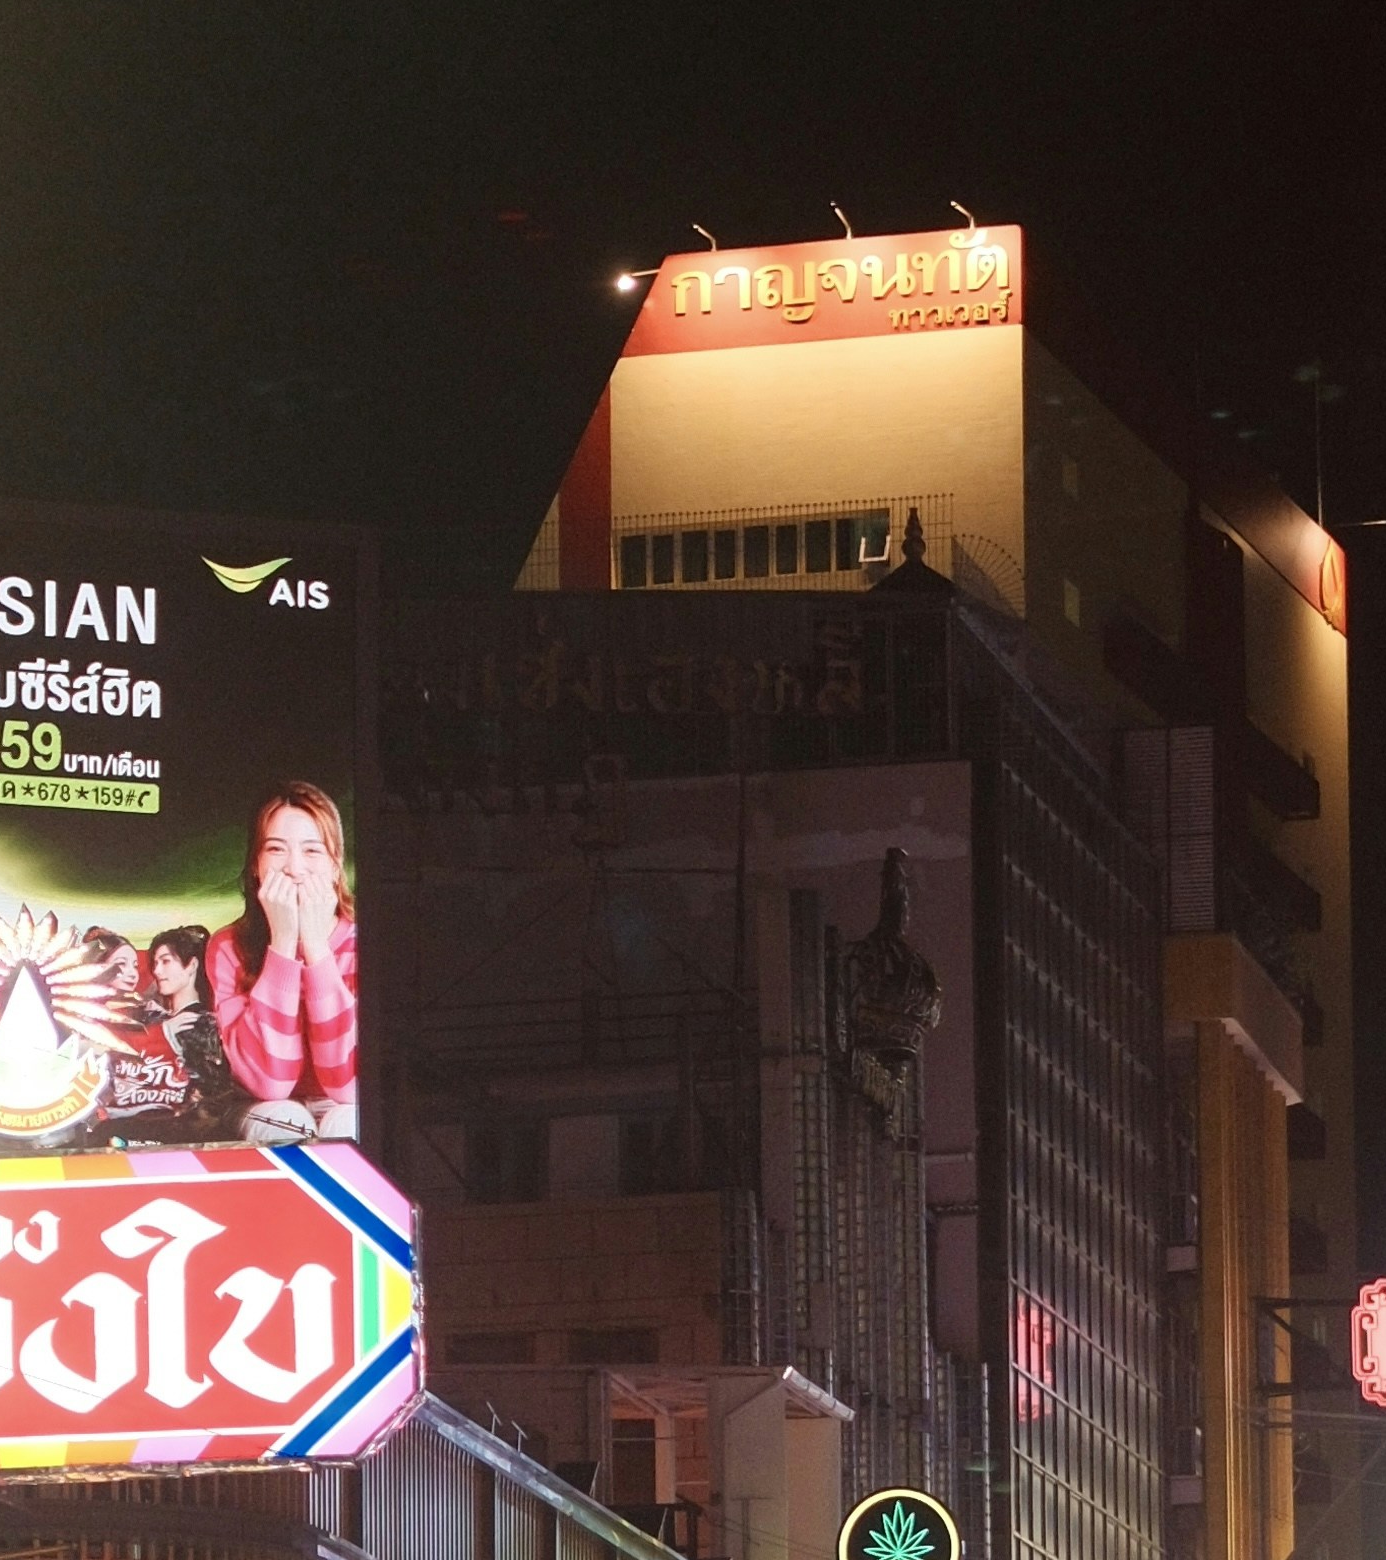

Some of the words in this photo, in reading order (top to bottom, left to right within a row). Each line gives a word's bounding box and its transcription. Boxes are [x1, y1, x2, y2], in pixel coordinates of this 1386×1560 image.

[670, 228, 1011, 322] กาญจนทัต
[887, 287, 1013, 330] ทาวเวอร์
[269, 578, 331, 611] AIS
